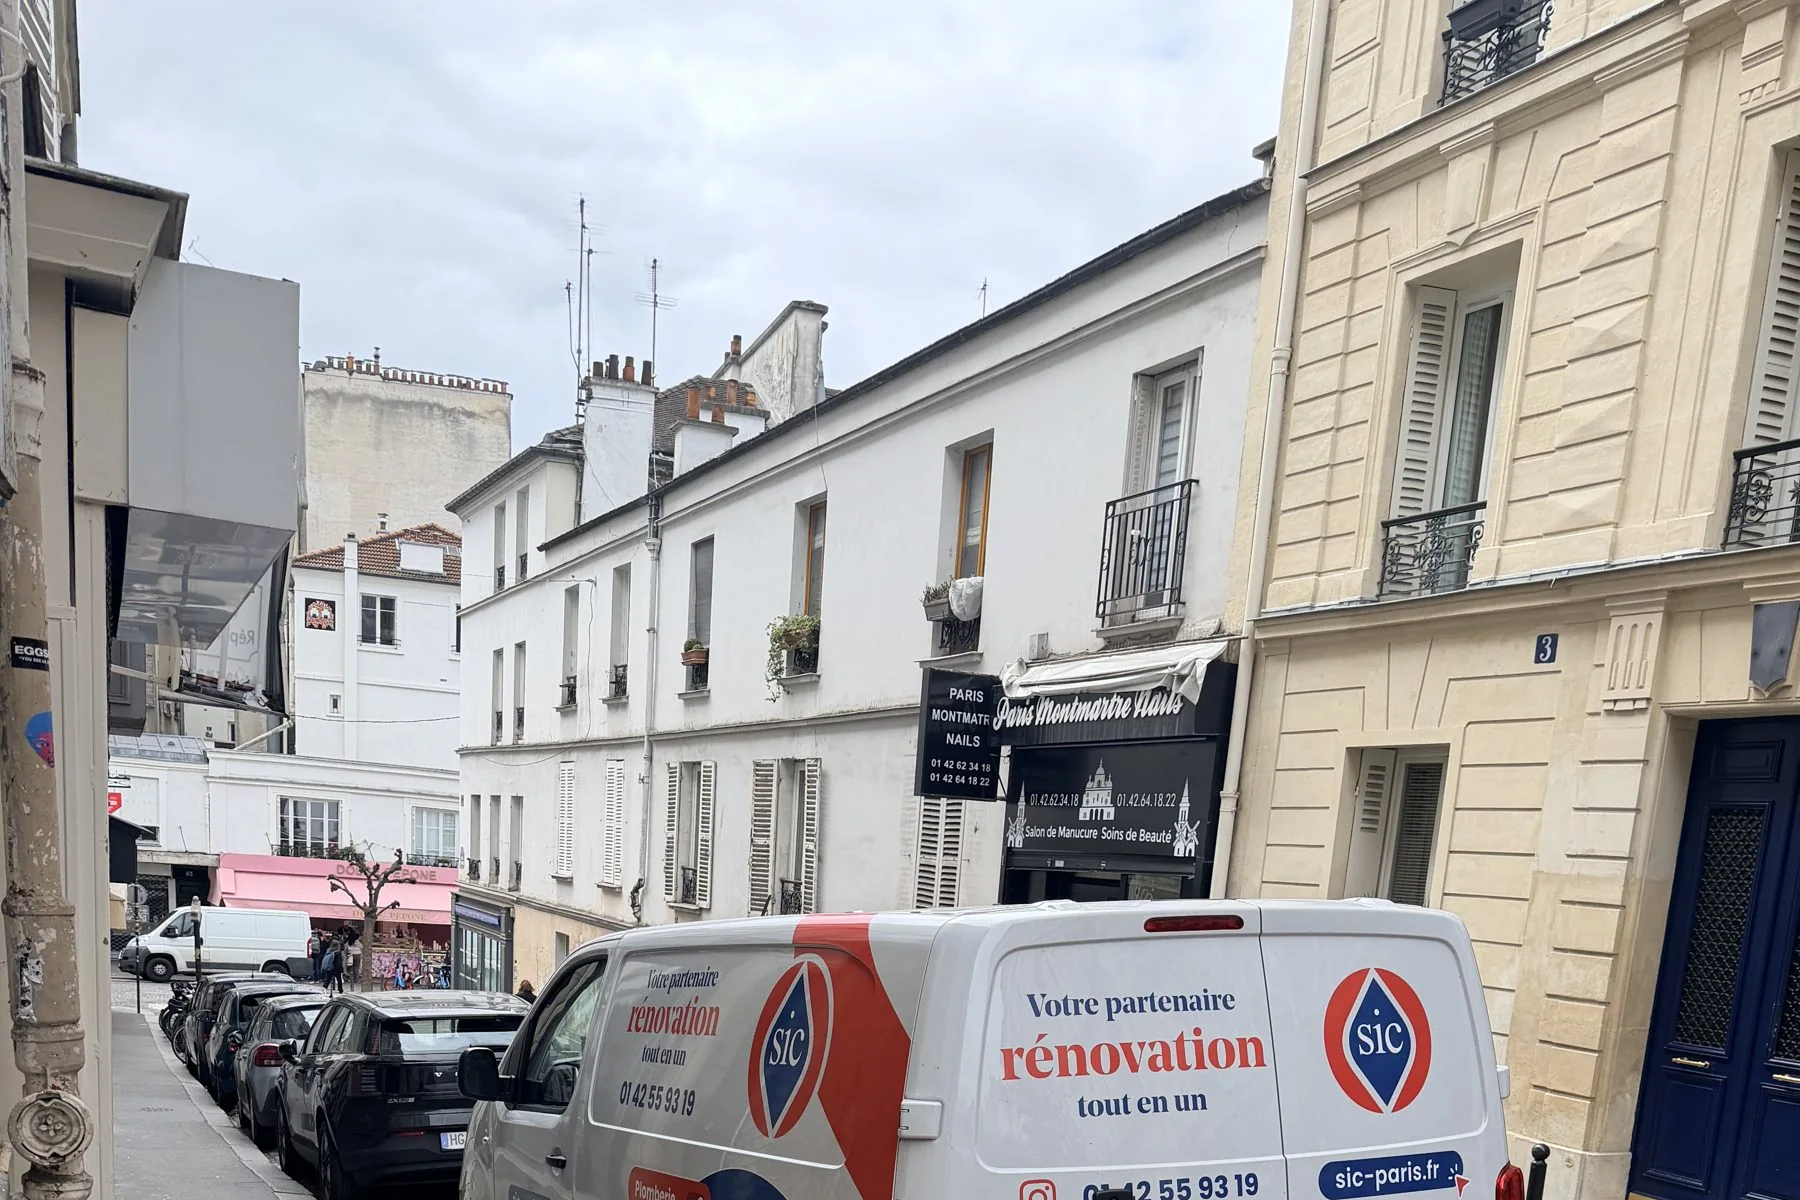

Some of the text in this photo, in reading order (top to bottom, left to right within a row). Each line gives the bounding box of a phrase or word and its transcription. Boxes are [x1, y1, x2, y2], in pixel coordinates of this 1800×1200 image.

[14, 644, 48, 658] EGGS
[1540, 636, 1552, 662] 3
[949, 687, 984, 703] PARIS
[993, 688, 1184, 731] Paris Montmartre Nails
[945, 732, 981, 748] NAILS
[931, 758, 991, 772] 01 42 62 34 18
[930, 772, 990, 786] 01 42 64 18 22
[1029, 792, 1177, 808] 01.42.62.34.18 01.42.64.18.22
[1025, 825, 1172, 844] Salon de Manucure Soins de Beauté
[648, 966, 719, 994] Votre partenaire
[626, 995, 720, 1037] rénovation
[1026, 988, 1236, 1022] Votre partenaire
[641, 1044, 687, 1066] tout en un
[1000, 1026, 1267, 1080] rénovation
[619, 1080, 696, 1117] 01 42 55 93 19
[1077, 1093, 1209, 1118] tout en un
[1198, 1175, 1229, 1200] 93
[1234, 1172, 1259, 1197] 19
[1335, 1159, 1440, 1192] sic-paris.fr
